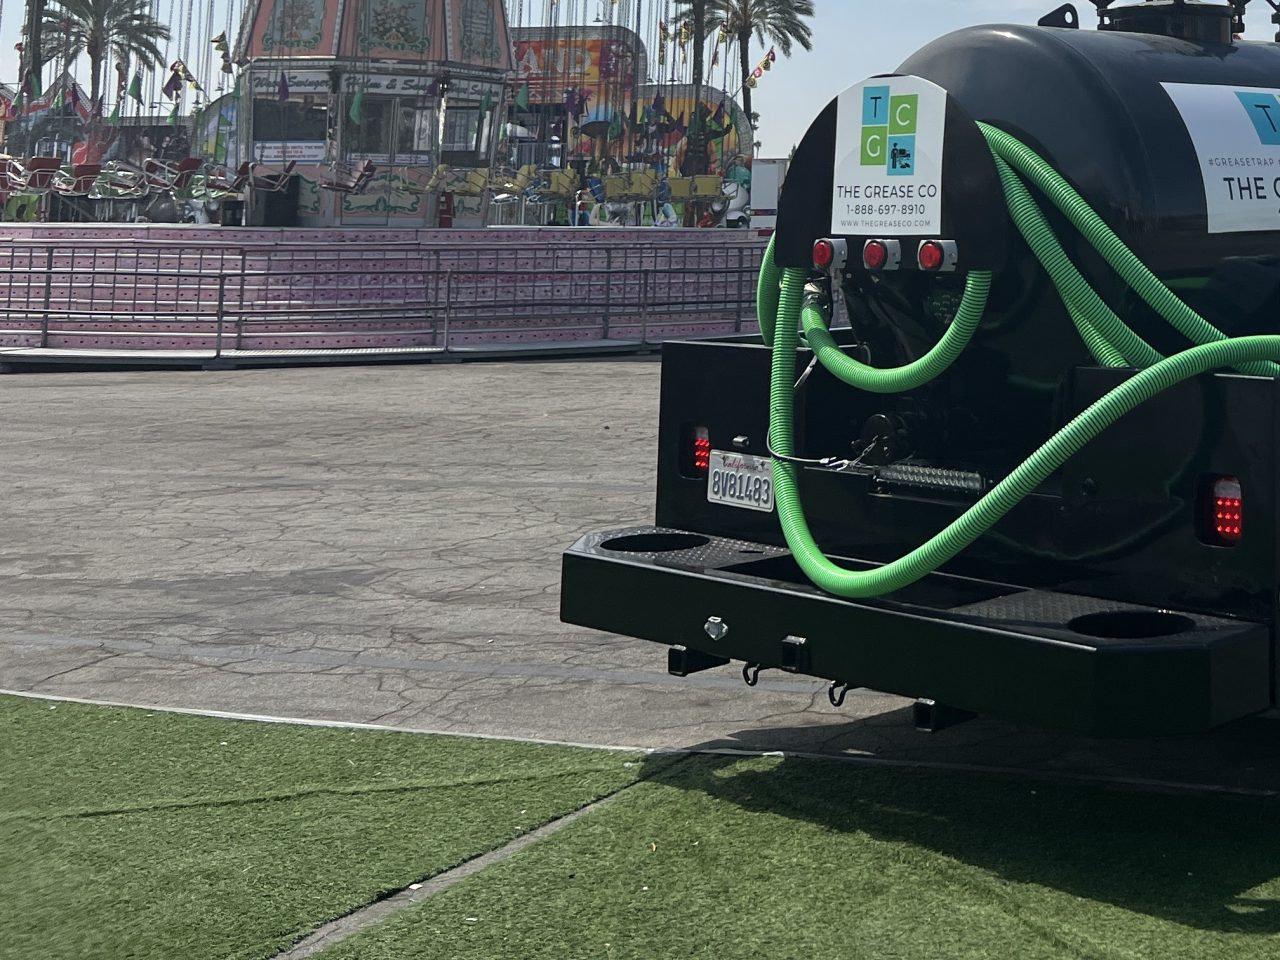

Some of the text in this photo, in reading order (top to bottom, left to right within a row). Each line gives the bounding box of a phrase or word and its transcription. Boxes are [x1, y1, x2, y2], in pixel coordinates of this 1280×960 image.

[869, 96, 882, 118] T
[895, 103, 911, 126] C
[866, 135, 881, 158] G
[1208, 158, 1274, 167] #GREASETRAP
[837, 184, 937, 198] THE GREASE CO
[1223, 177, 1267, 200] THE
[846, 204, 925, 215] 1-888-697-8910
[713, 470, 770, 504] 8V81483
